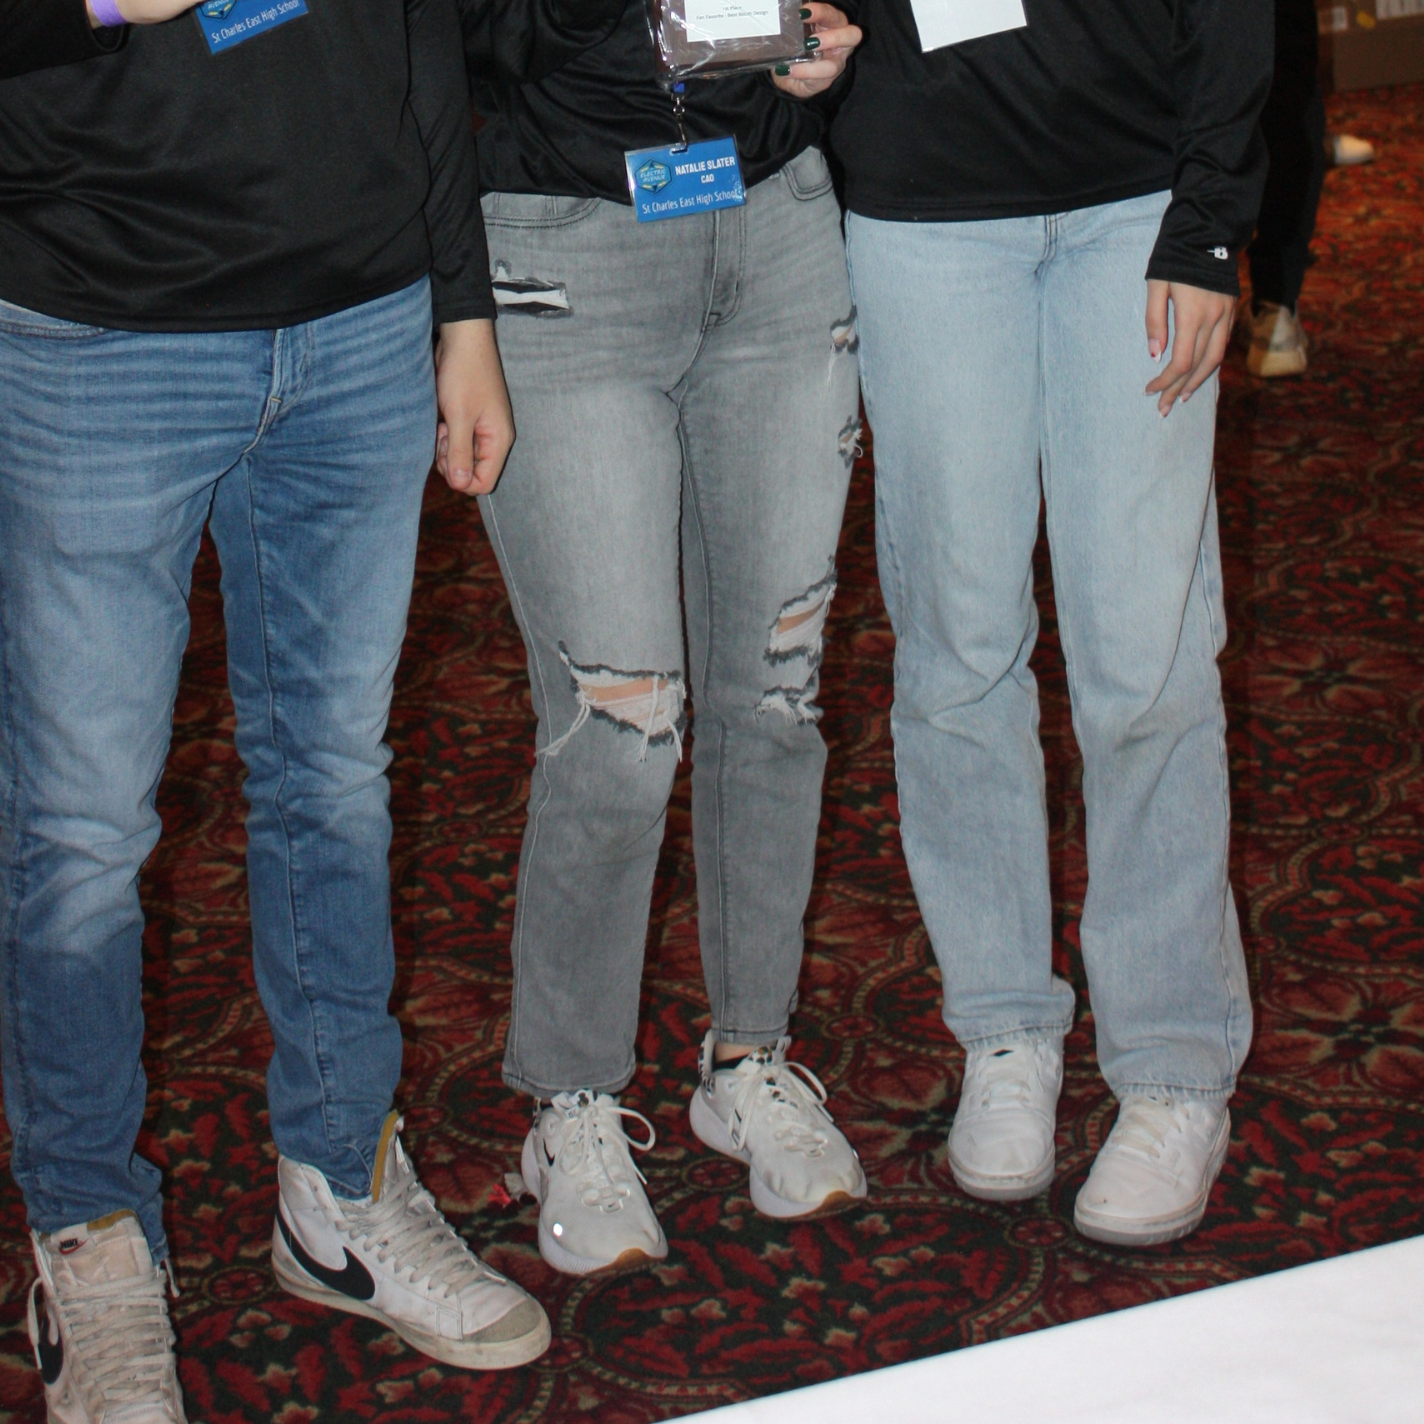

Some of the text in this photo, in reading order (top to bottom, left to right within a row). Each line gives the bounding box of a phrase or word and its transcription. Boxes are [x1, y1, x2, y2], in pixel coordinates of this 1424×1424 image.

[211, 32, 221, 44] St
[220, 21, 247, 39] Charles
[245, 15, 262, 29] East
[261, 7, 278, 22] High
[674, 155, 736, 176] NATALIE SLATER
[700, 173, 715, 184] CAO
[642, 188, 739, 214] St Charles East High School
